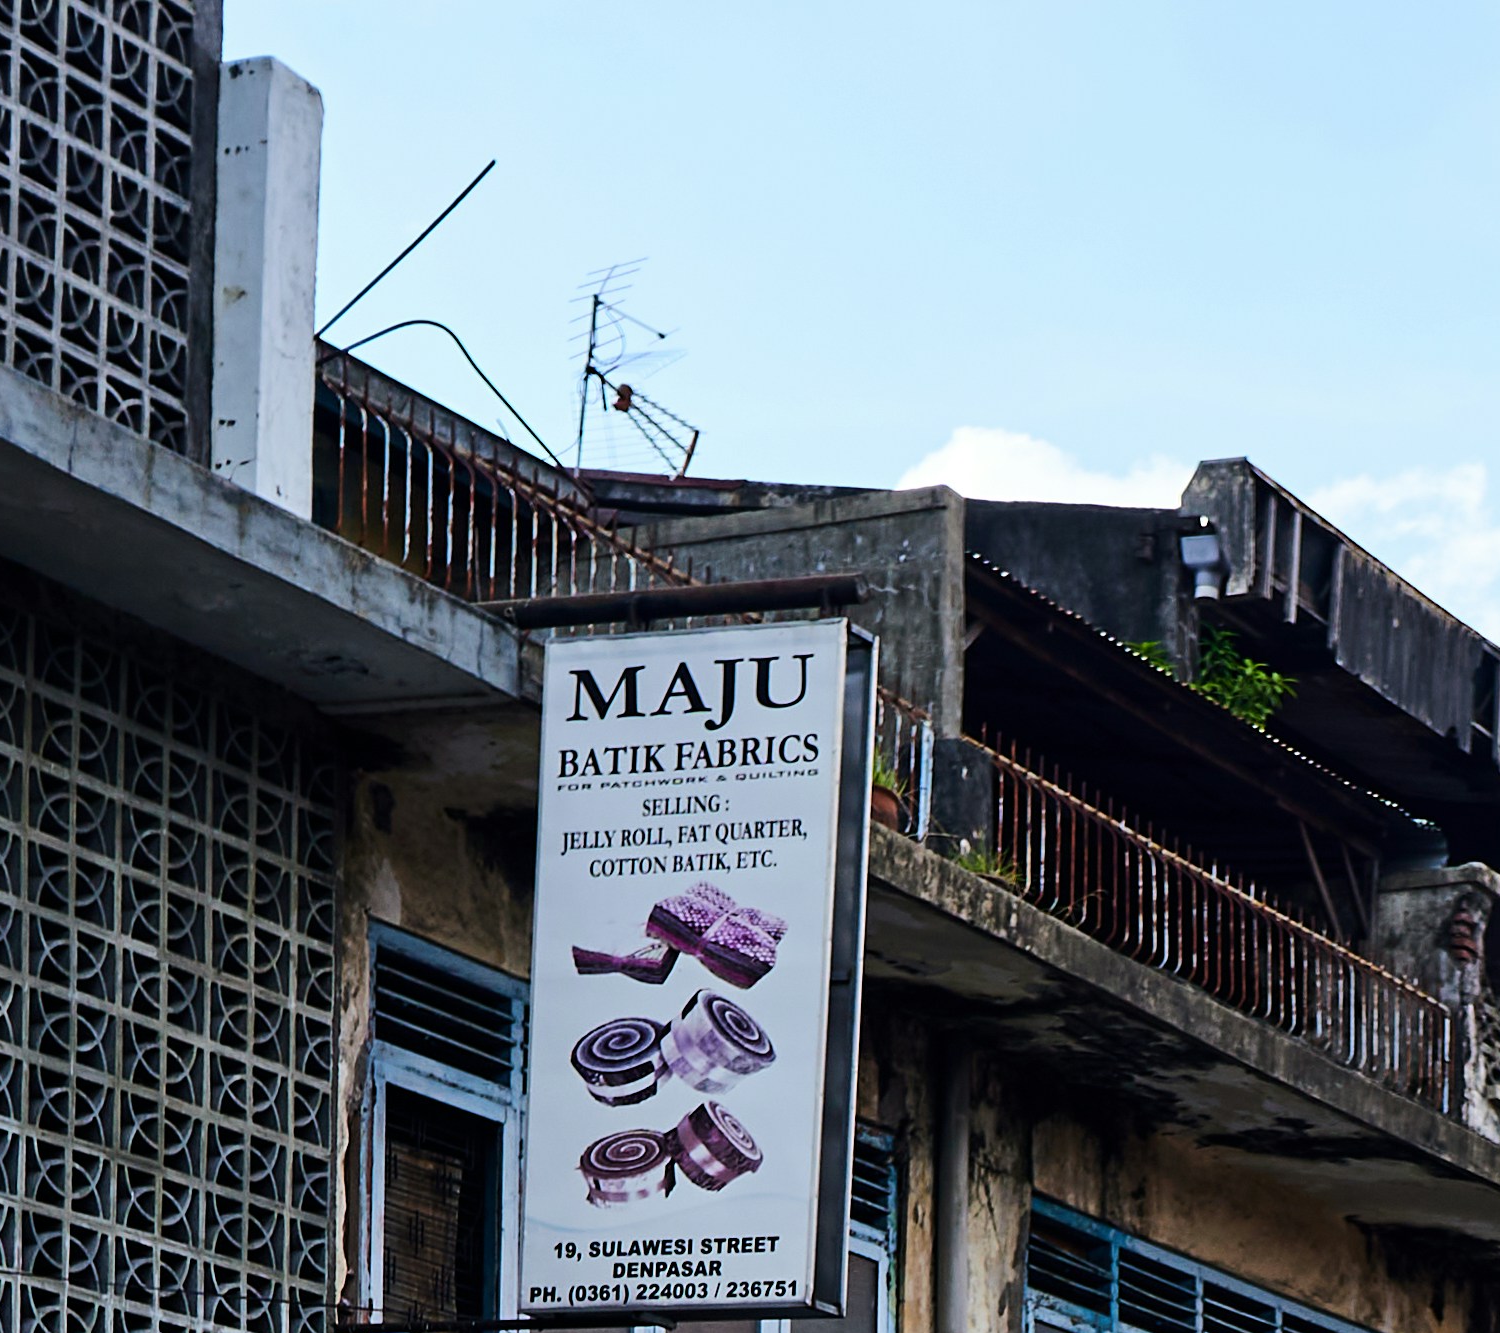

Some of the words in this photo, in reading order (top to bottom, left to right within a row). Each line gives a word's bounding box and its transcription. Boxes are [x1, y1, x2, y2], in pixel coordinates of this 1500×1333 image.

[565, 654, 815, 731] MAJU
[557, 744, 665, 778] BATIK
[675, 734, 819, 773] FABRICS
[557, 783, 593, 792] FOR
[601, 776, 707, 789] PATCHWORK
[716, 775, 728, 783] &
[735, 769, 819, 781] QUILTING
[642, 794, 721, 817] SELLING
[561, 830, 617, 856] JELLY
[620, 827, 673, 849] ROLL,
[677, 824, 712, 844] FAT
[715, 819, 808, 845] QUARTER,
[588, 856, 668, 878] COTTON
[671, 852, 731, 874] BATIK,
[736, 849, 778, 870] ETC.
[554, 1242, 582, 1261] 19,
[588, 1239, 694, 1259] SULAWESI
[700, 1235, 780, 1255] STREET
[612, 1260, 723, 1279] DENPASAR
[529, 1287, 562, 1303] PH.
[569, 1284, 630, 1306] (0361)
[636, 1282, 709, 1300] 224003
[726, 1280, 799, 1298] 236751
